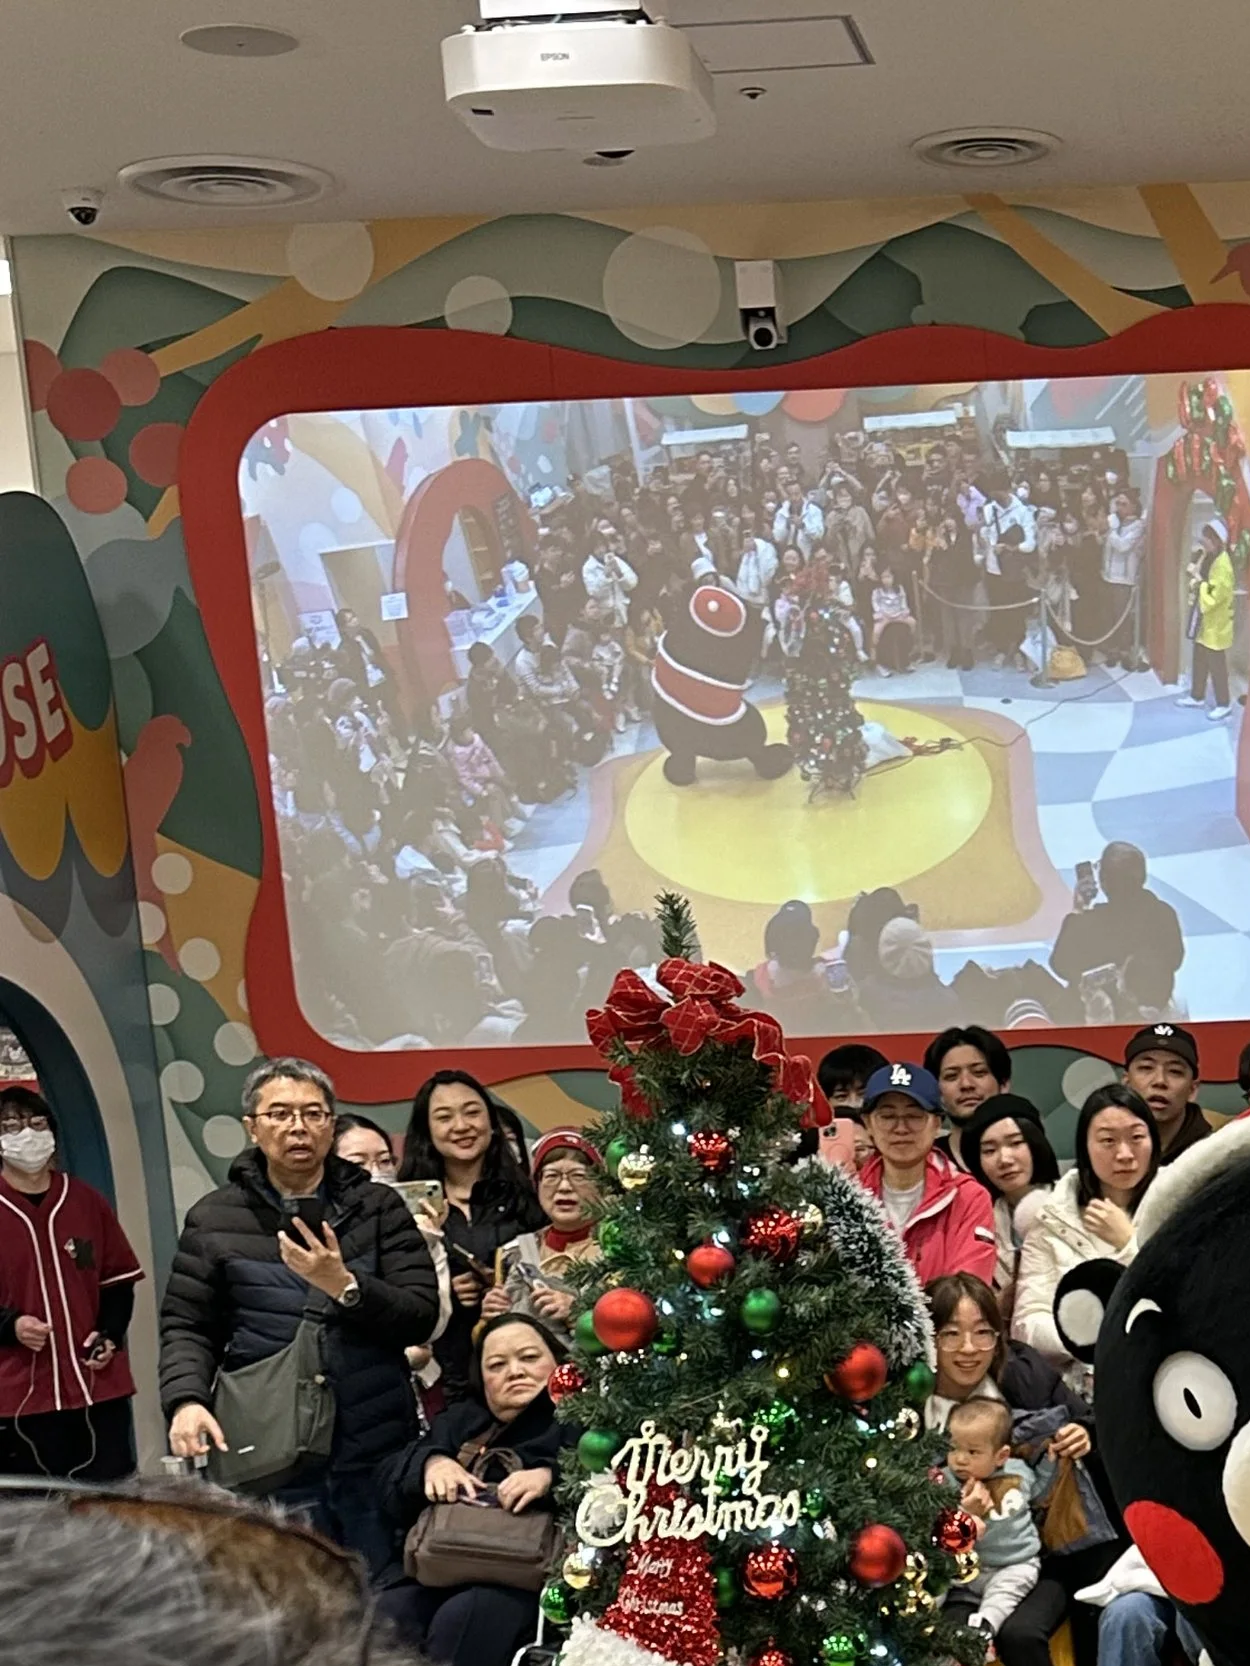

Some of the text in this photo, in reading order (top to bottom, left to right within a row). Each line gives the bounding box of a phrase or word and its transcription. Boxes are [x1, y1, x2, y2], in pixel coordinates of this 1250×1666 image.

[540, 52, 570, 61] EPSON
[0, 638, 69, 772] SE
[889, 1063, 912, 1086] LA
[611, 1421, 770, 1496] Merry
[575, 1485, 800, 1547] Christmas
